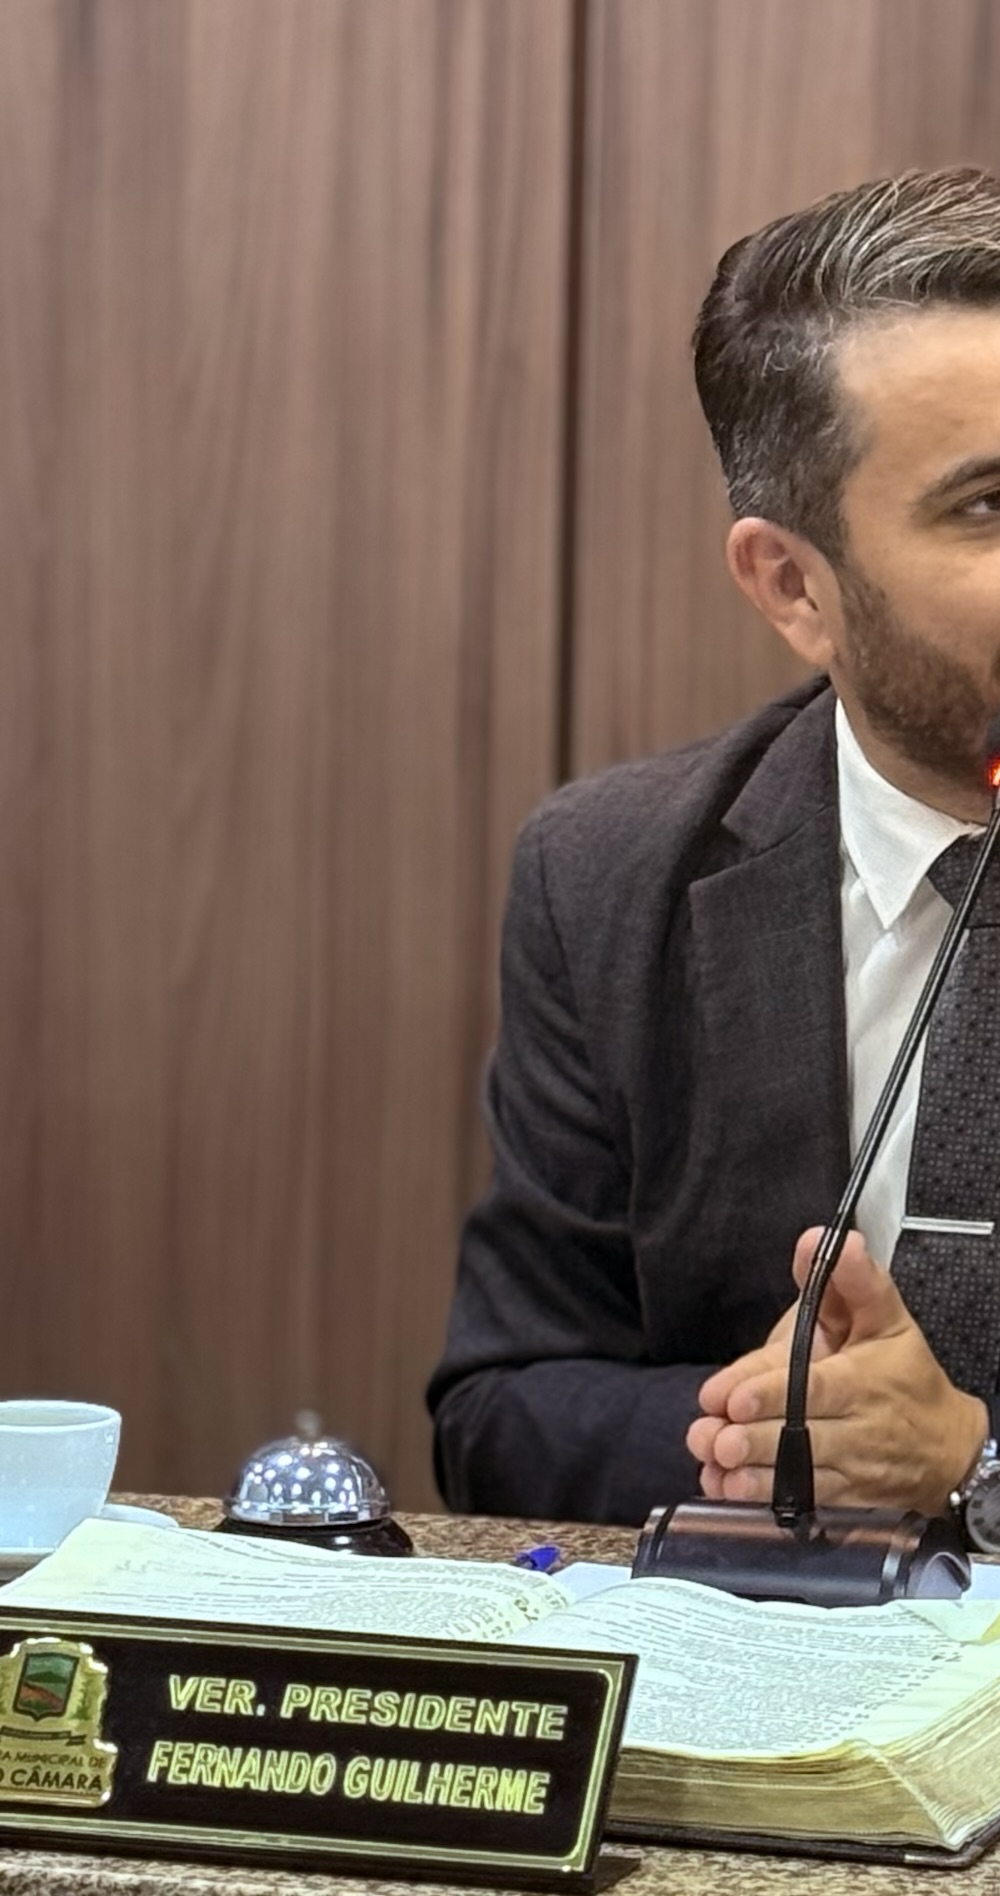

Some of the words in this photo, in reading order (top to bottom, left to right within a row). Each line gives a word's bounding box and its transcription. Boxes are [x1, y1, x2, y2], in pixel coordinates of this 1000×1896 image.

[168, 1674, 266, 1716] VER.
[280, 1683, 568, 1741] PRESIDENTE
[10, 1764, 103, 1792] CÂMARA
[146, 1740, 337, 1796] FERNANDO
[343, 1755, 551, 1814] GUILHERME
